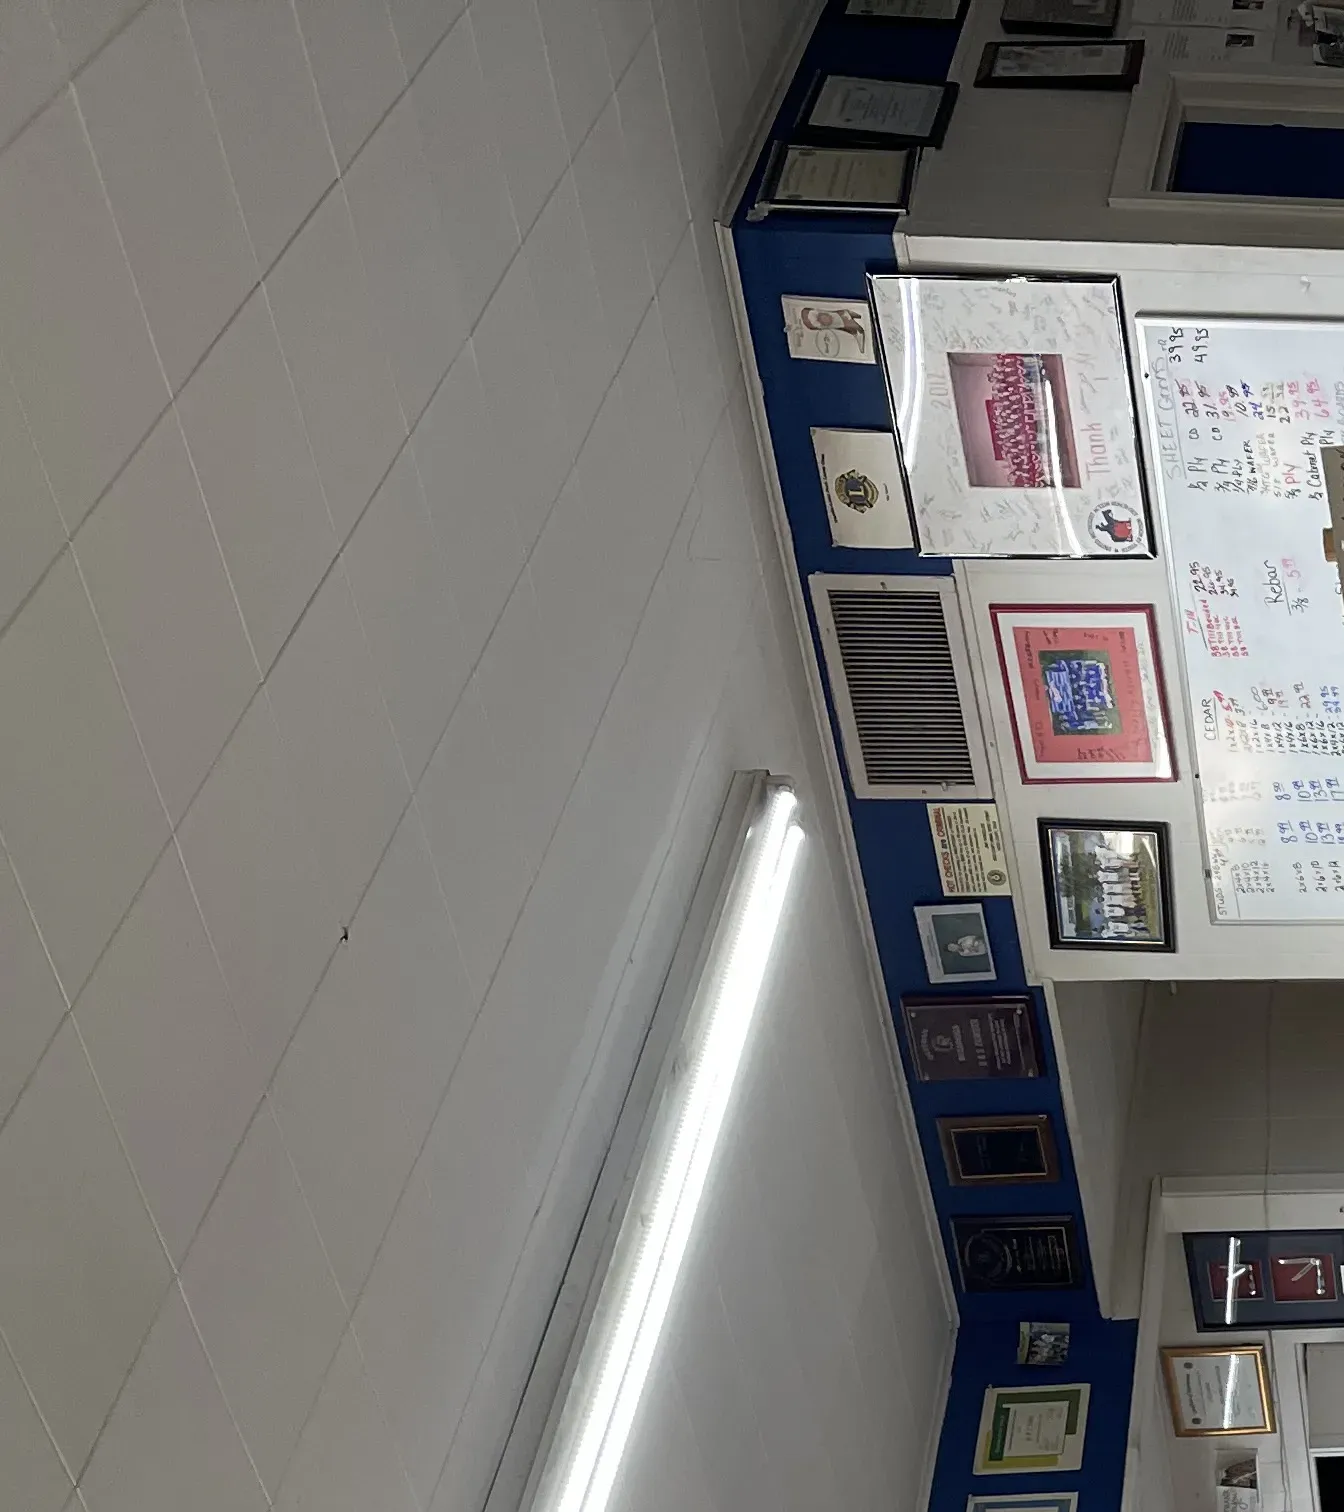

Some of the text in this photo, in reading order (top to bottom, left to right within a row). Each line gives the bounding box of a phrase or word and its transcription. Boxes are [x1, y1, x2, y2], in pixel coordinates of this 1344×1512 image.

[1262, 560, 1284, 606] Rebar
[932, 807, 945, 837] CRIMINAL
[941, 852, 953, 878] CHECKS
